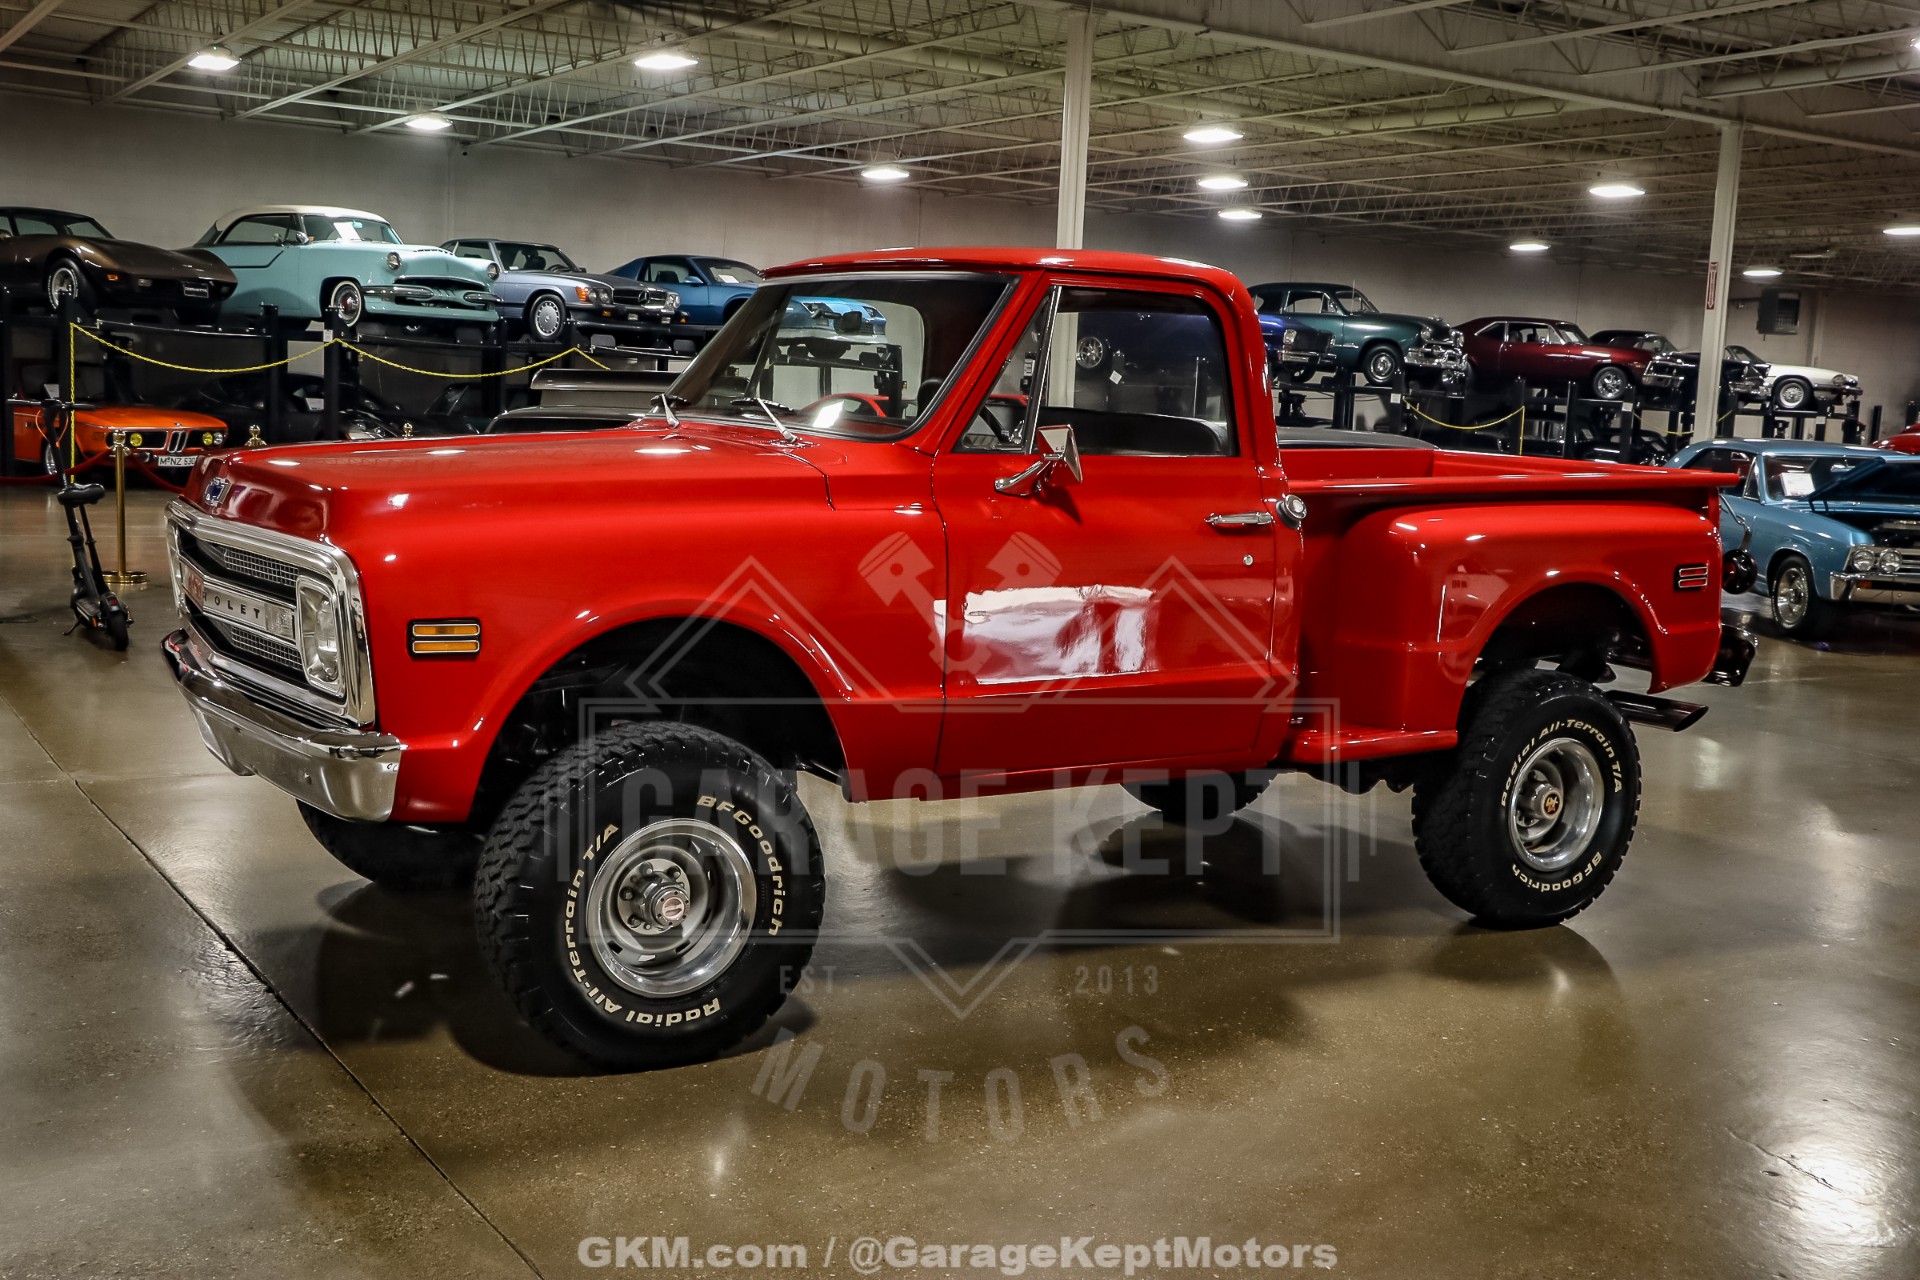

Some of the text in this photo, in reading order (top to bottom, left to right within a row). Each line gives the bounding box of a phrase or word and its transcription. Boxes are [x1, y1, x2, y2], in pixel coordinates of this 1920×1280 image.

[1501, 718, 1623, 807] Radial All-Terrain T/A
[696, 795, 786, 936] BFGoodrich
[1511, 851, 1602, 892] BFGoodrich
[565, 823, 721, 1027] Radial All-Terrain T/A
